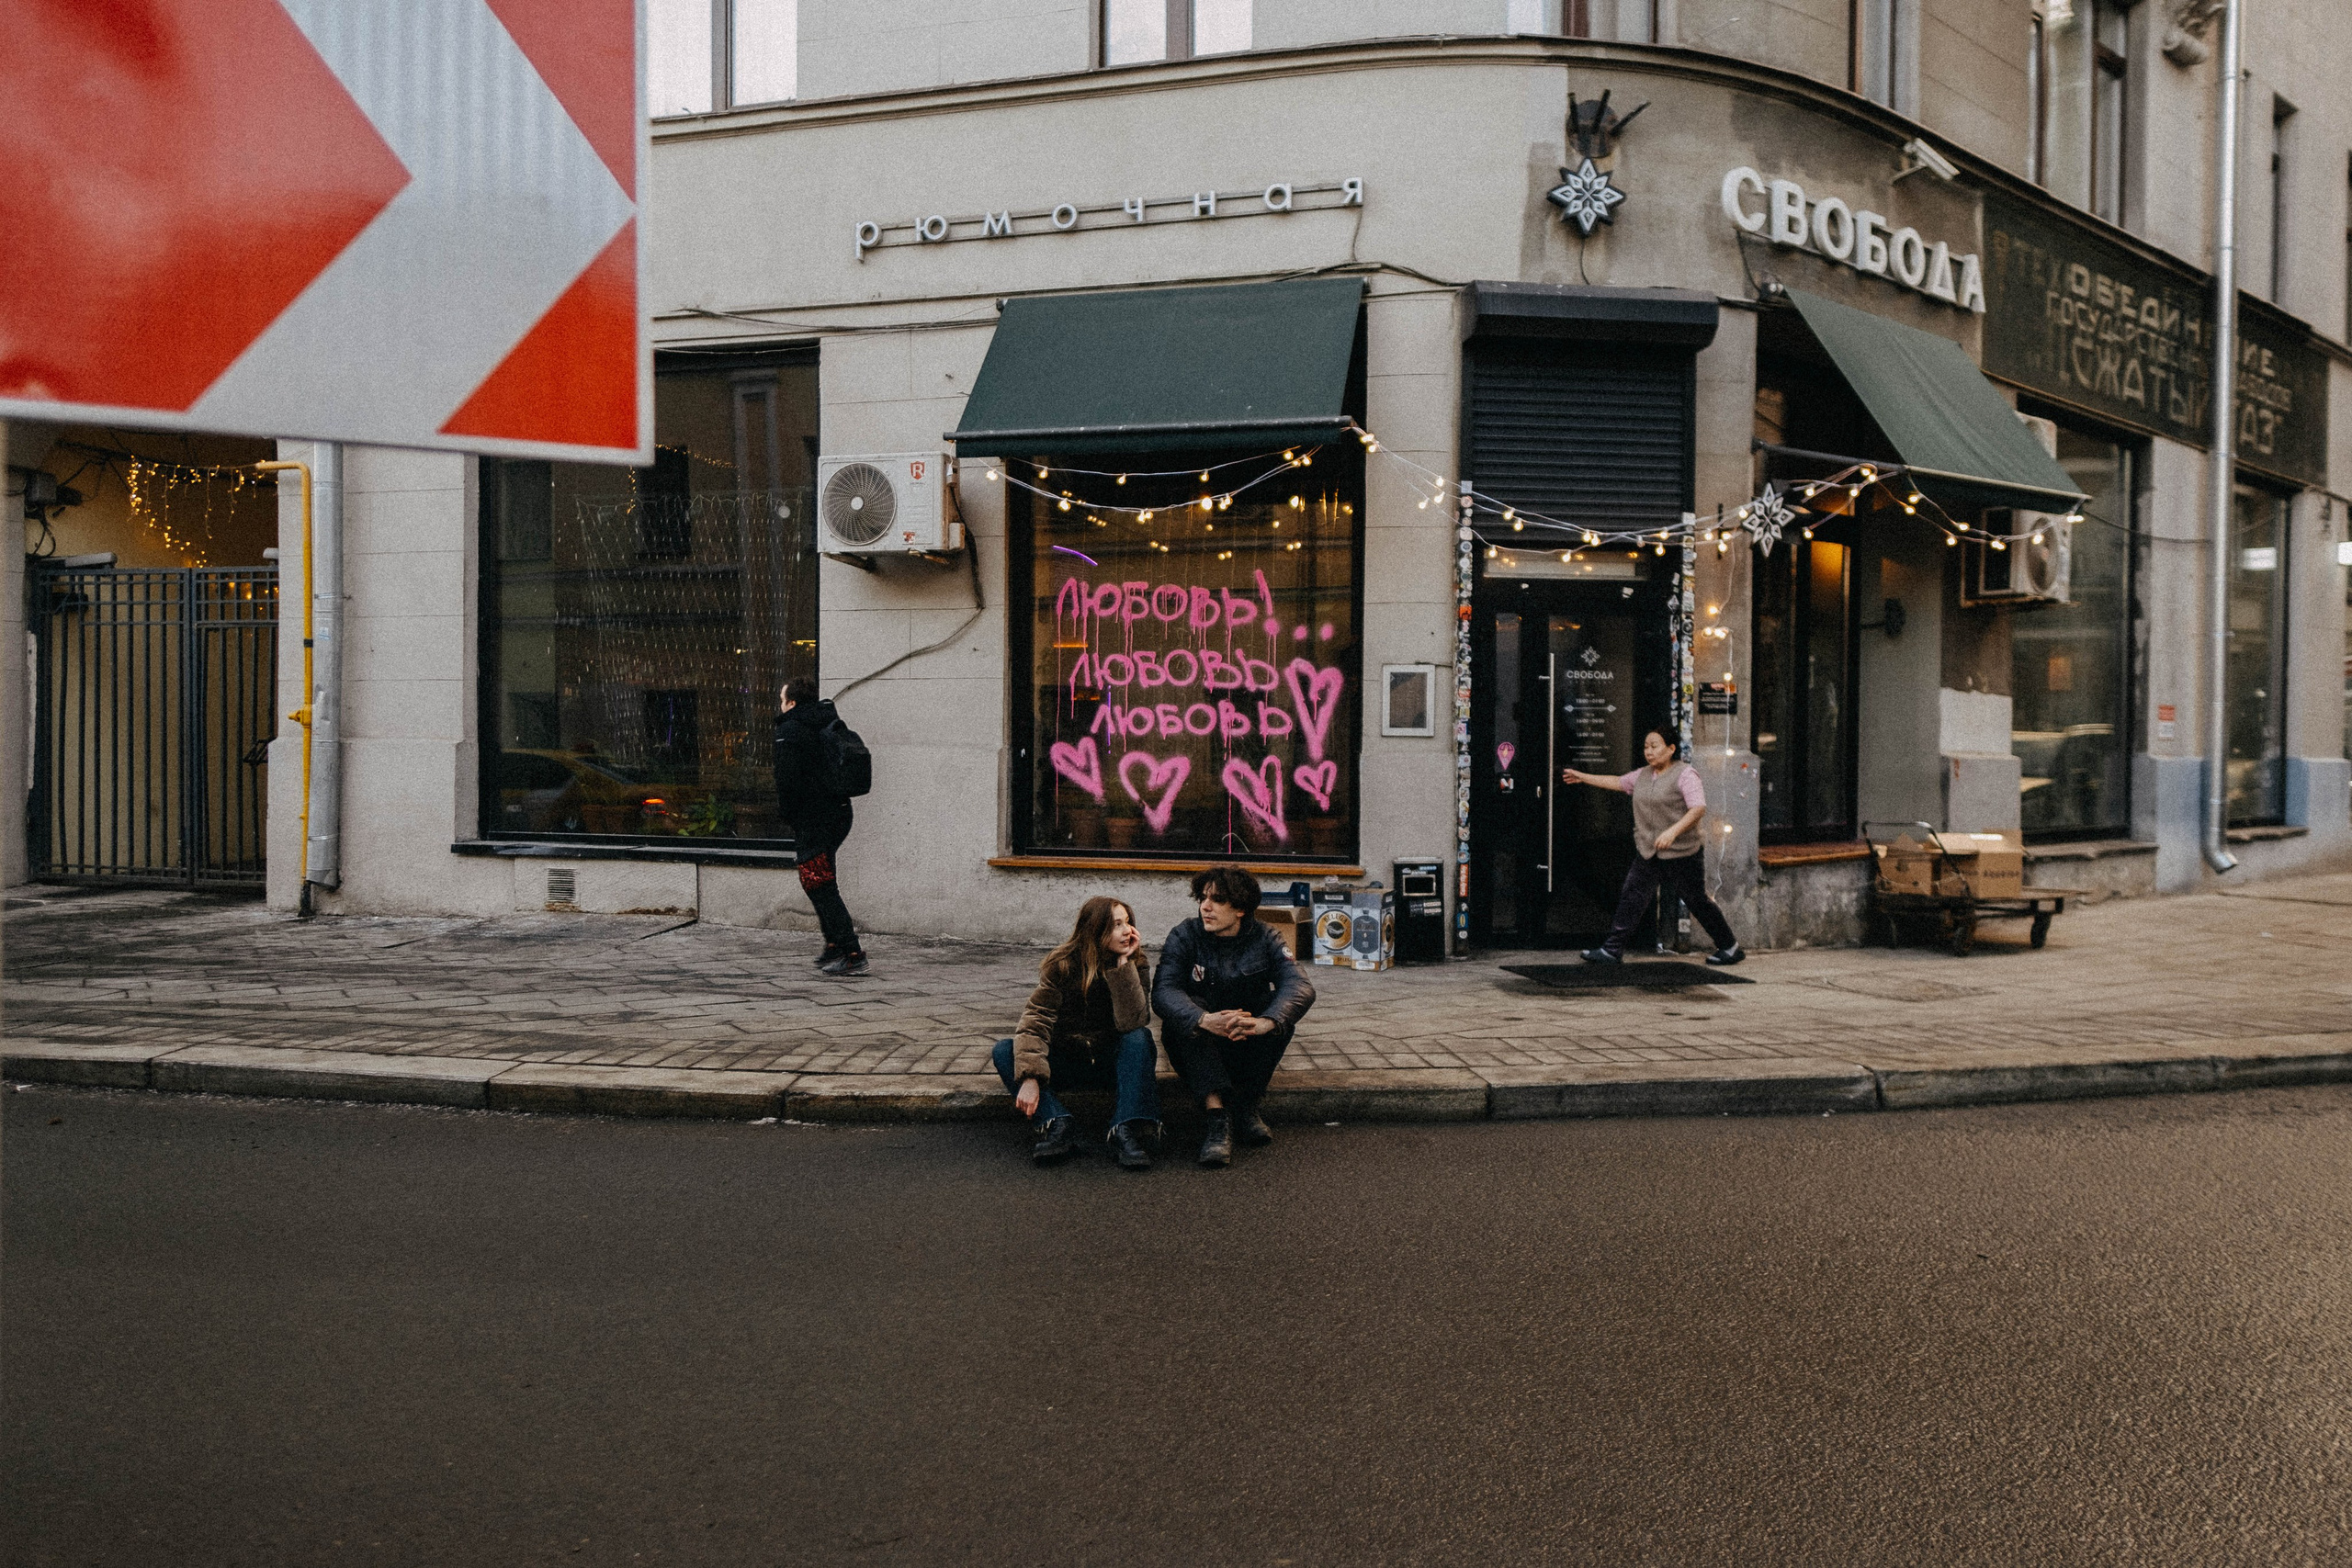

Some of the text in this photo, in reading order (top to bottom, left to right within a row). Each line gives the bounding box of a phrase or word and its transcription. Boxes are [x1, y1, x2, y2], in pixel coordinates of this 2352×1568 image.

[855, 176, 1364, 263] рюмочная
[1721, 165, 1986, 313] СВОБОДА
[1069, 648, 1280, 693] ЛЮБОВЬ
[1566, 670, 1614, 679] СВОБОДА
[1091, 699, 1293, 740] ЛЮБОВЬ
